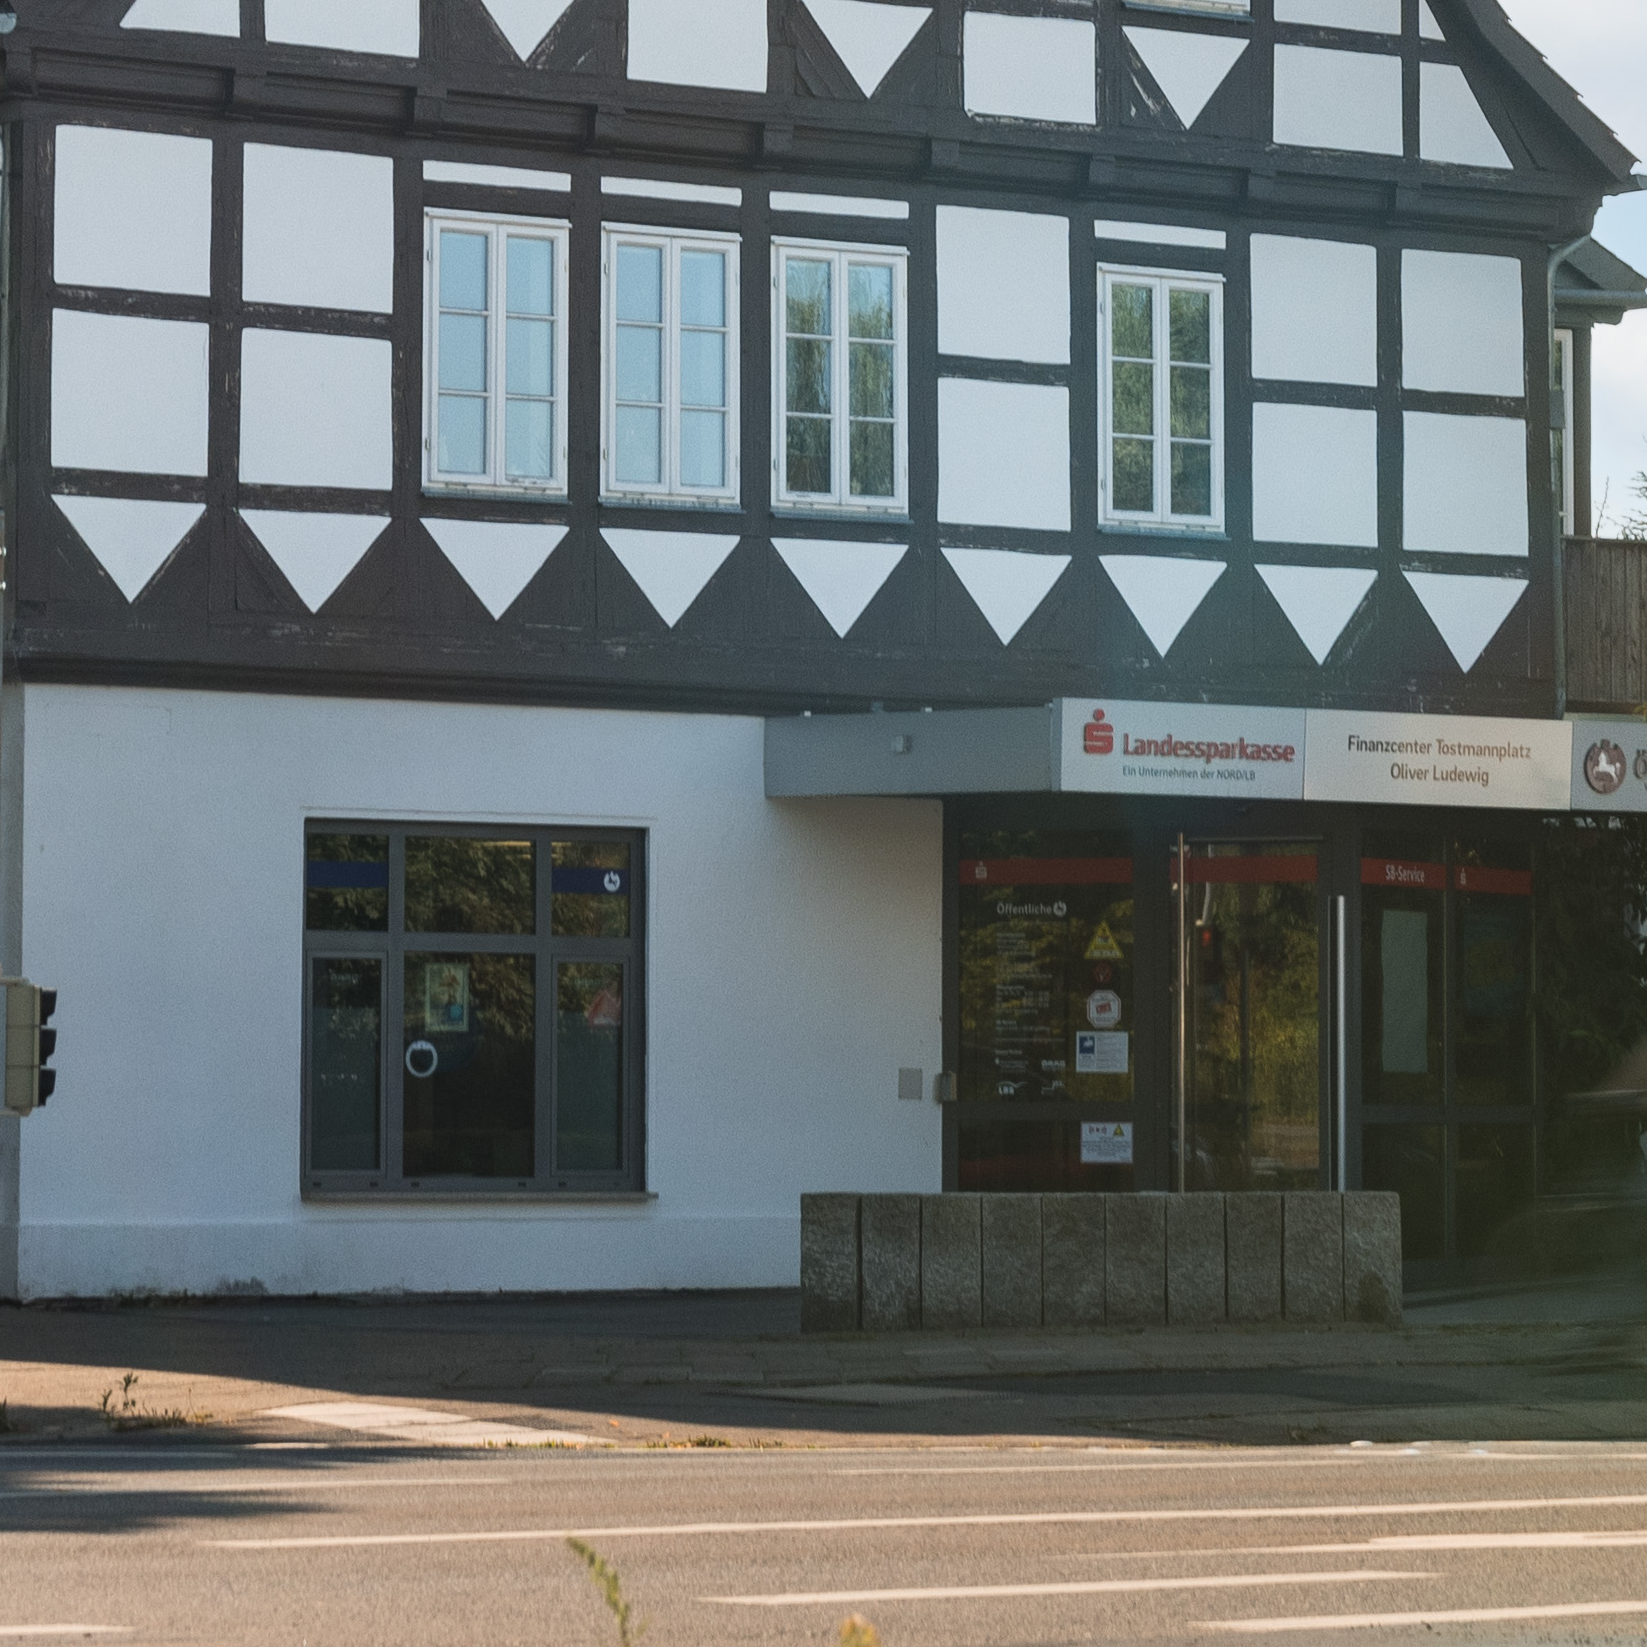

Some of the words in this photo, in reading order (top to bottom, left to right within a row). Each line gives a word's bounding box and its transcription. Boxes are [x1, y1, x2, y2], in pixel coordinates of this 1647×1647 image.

[1123, 733, 1296, 764] Landessparkasse
[1347, 734, 1432, 755] Finanzcenter
[1435, 738, 1532, 762] Tostmannplatz
[1122, 765, 1137, 778] Ein
[1138, 766, 1198, 780] Unternehmen
[1200, 768, 1215, 780] der
[1216, 769, 1256, 781] NORD/LB
[1390, 762, 1430, 781] Oliver
[1432, 764, 1490, 787] Ludewig
[1385, 864, 1425, 883] SB-Service
